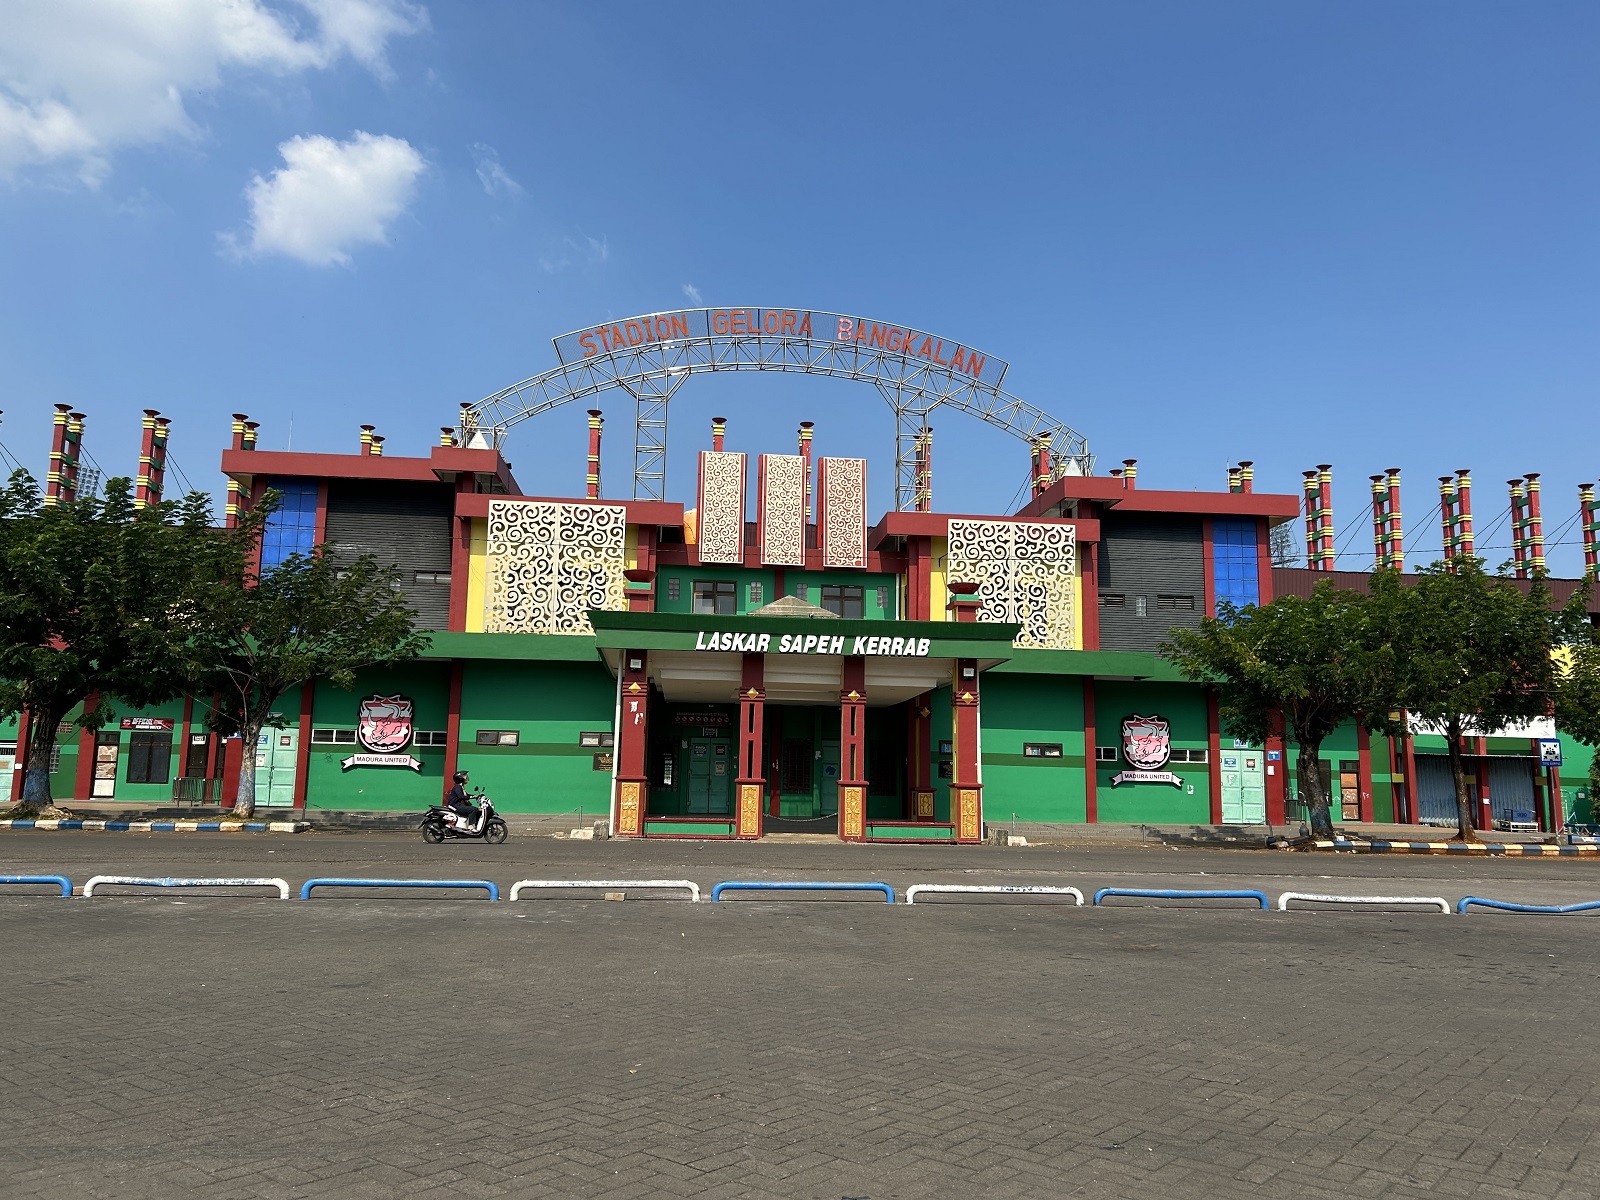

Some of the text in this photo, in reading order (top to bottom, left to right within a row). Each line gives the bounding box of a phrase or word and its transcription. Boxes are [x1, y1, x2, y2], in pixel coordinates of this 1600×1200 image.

[579, 310, 985, 378] STADION GELORA BANGKALAN
[695, 631, 931, 657] LASKAR SAPEH KERRAB
